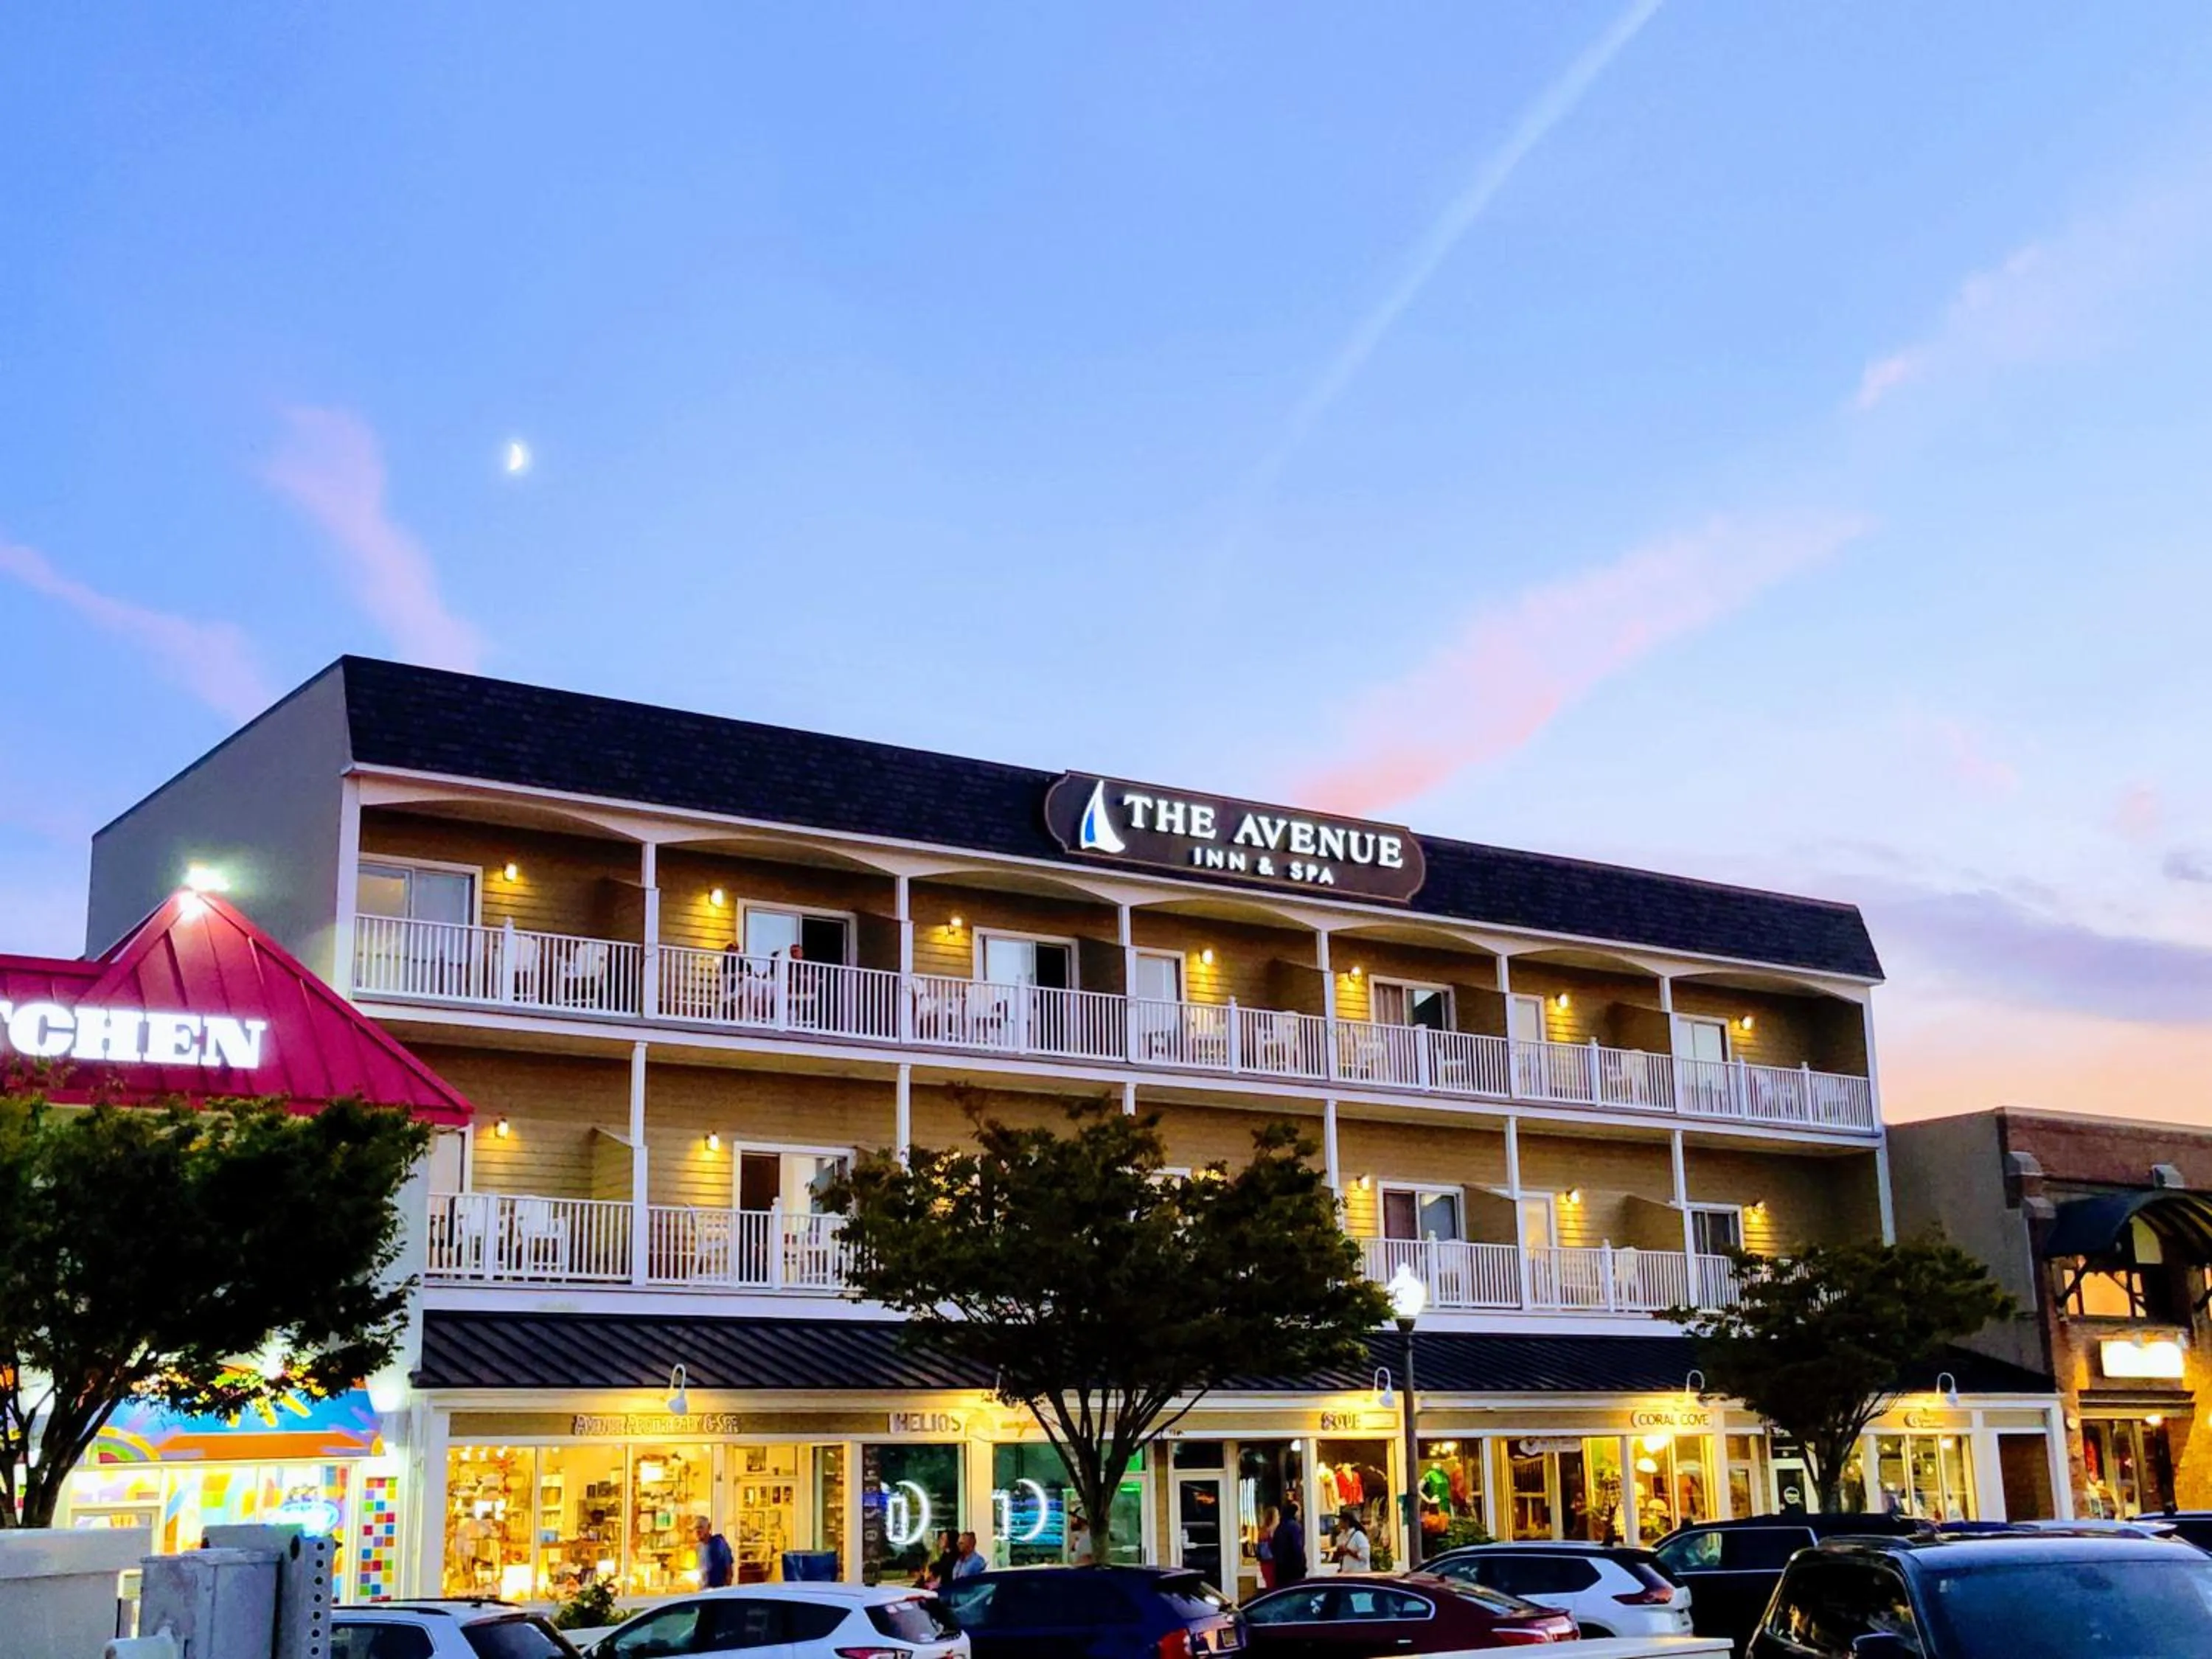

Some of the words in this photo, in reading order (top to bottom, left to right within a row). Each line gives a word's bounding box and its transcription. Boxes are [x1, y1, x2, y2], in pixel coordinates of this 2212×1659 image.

[1123, 794, 1216, 839] THE
[1234, 814, 1403, 868] AVENUE
[1193, 847, 1247, 871] INN
[1258, 858, 1274, 876] &
[1289, 861, 1335, 885] SPA
[0, 1001, 266, 1069] CHEN
[894, 1413, 961, 1432] HELIOS
[1638, 1413, 1675, 1425] CORAL
[1680, 1413, 1709, 1425] COVE
